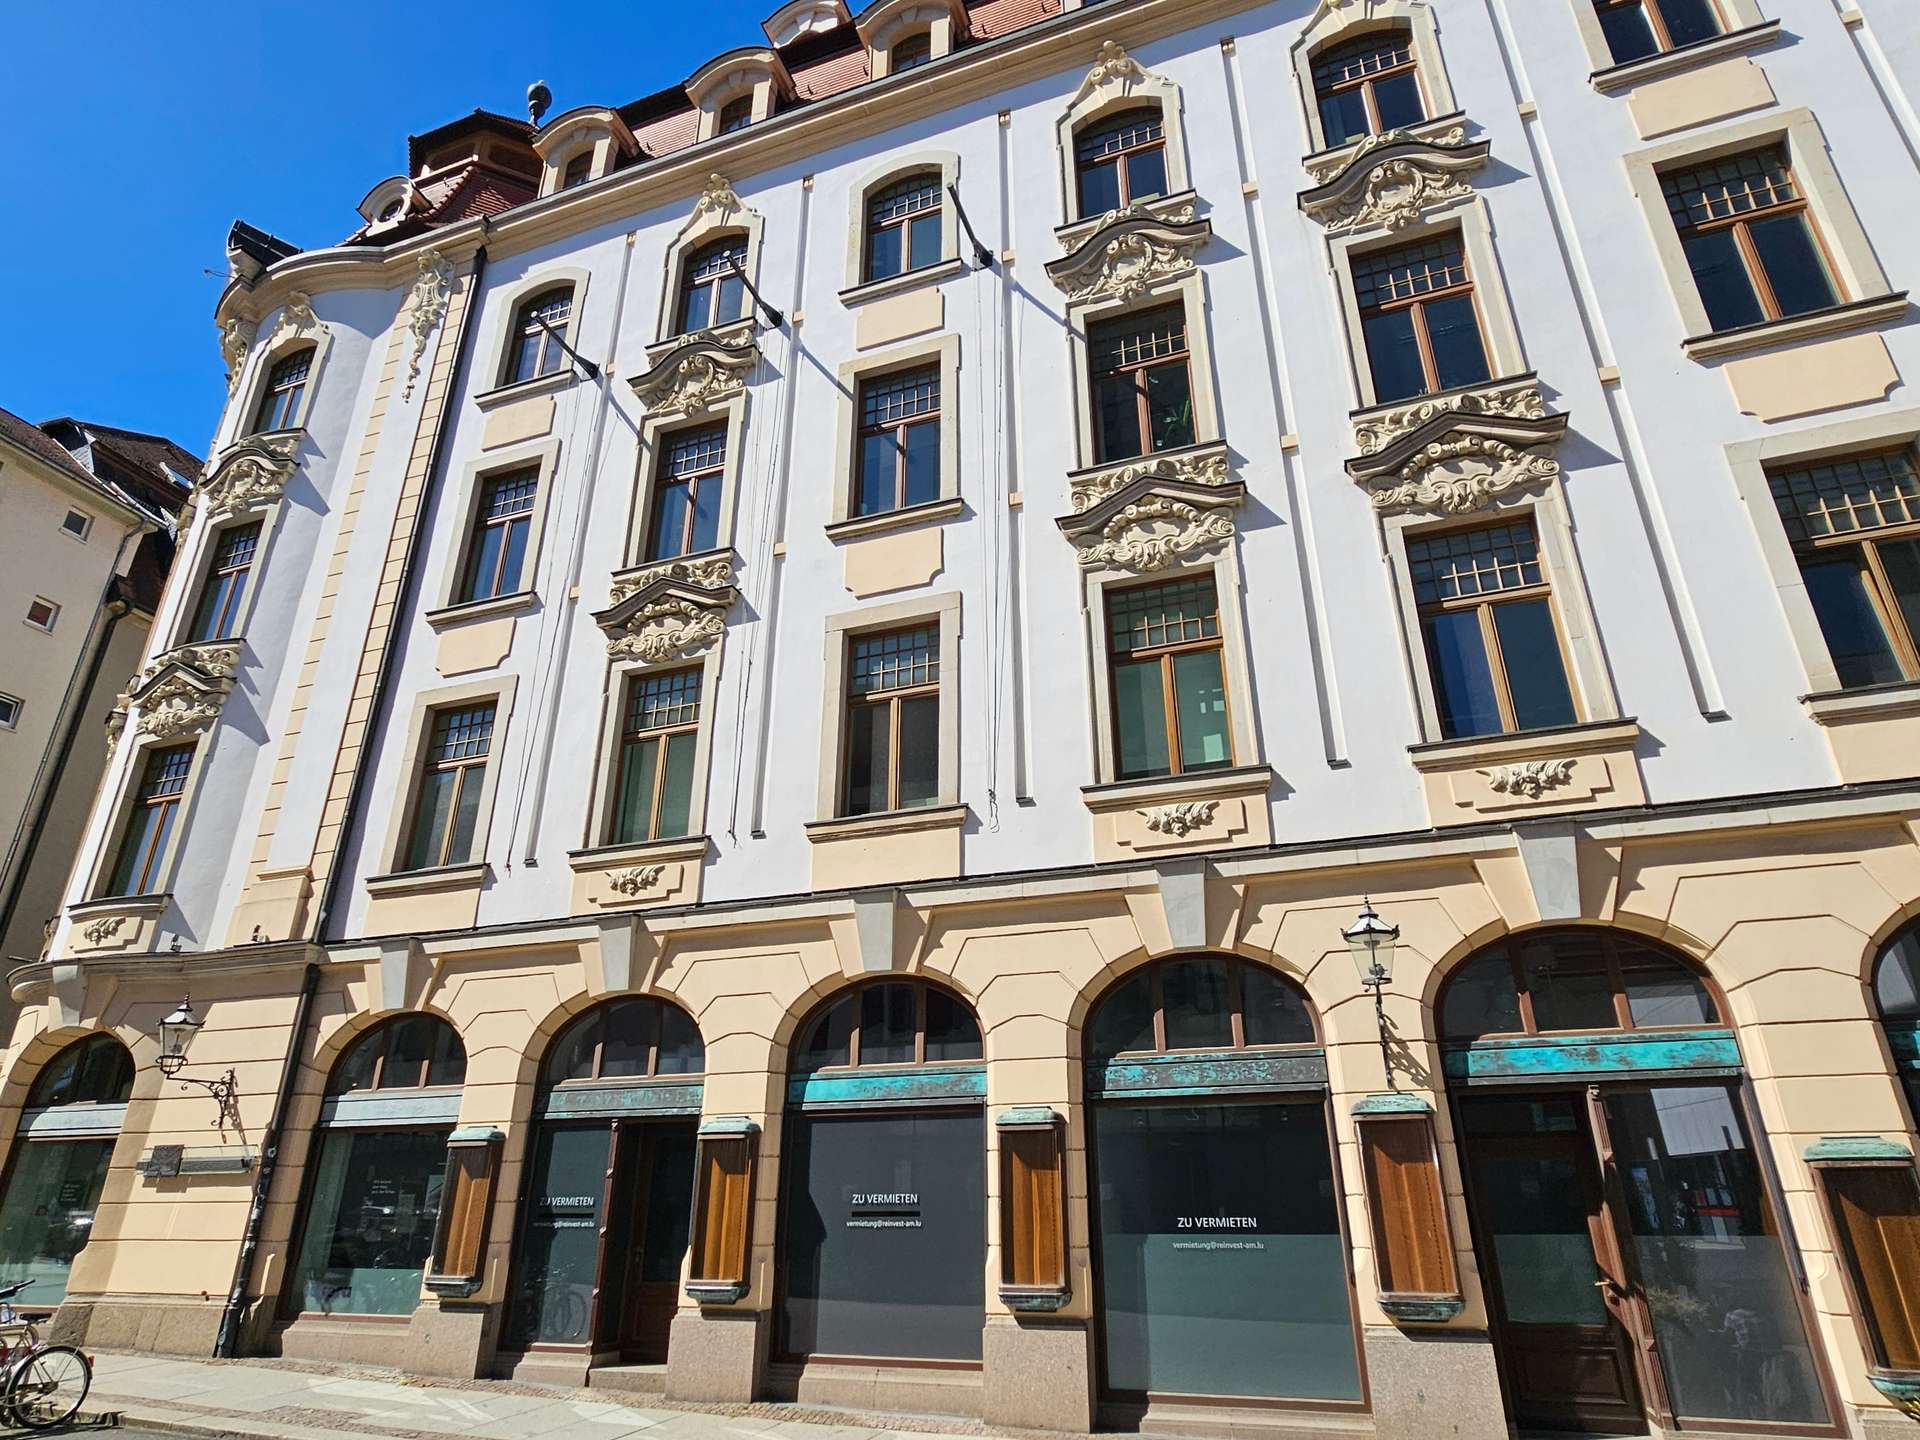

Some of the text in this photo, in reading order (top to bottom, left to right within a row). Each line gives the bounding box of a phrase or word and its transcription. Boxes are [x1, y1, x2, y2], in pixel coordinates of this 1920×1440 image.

[539, 1196, 594, 1206] ZU VERMIETEN
[852, 1194, 918, 1204] ZU VERMIETEN
[1177, 1217, 1257, 1228] ZU VERMIETEN
